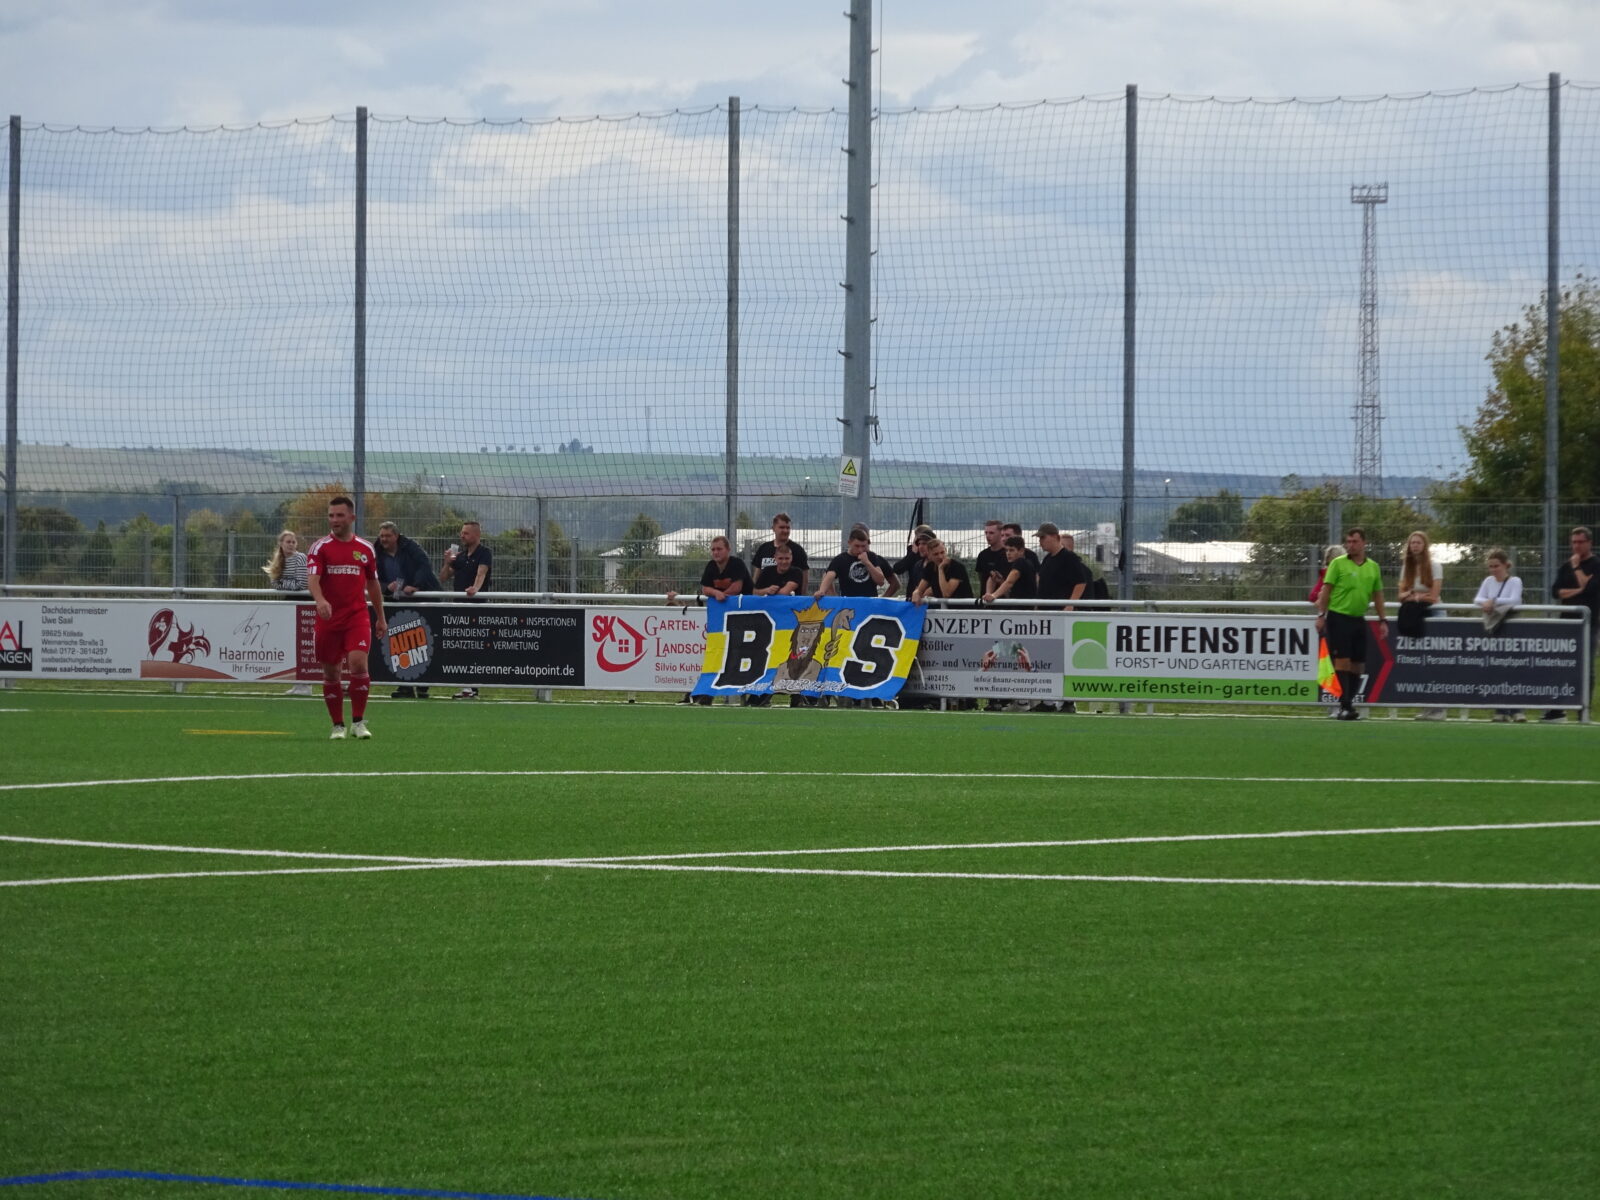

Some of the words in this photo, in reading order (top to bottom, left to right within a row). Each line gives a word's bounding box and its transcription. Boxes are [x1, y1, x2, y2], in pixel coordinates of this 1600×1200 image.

[42, 606, 108, 614] Dachdeckermeister
[58, 616, 73, 624] Saal
[443, 614, 470, 625] TÜV/AU
[478, 616, 518, 626] REPARATUR
[526, 617, 576, 626] INSPEKTIONEN
[922, 618, 992, 634] ONZEPT
[1000, 618, 1052, 636] GmbH
[443, 628, 490, 637] REIFENDIENST
[498, 629, 542, 638] NEUAUFBAU
[592, 615, 616, 642] SK
[389, 626, 427, 655] AUTO
[443, 640, 484, 650] ERSATZTEILE
[493, 641, 540, 650] VERMIETUNG
[1116, 625, 1310, 655] REIFENSTEIN
[1396, 636, 1462, 650] ZIERENNER
[1466, 636, 1576, 652] SPORTBETREUUNG
[219, 647, 284, 661] Haarmonie
[656, 638, 706, 658] LANDSCH
[712, 610, 776, 688] B
[840, 615, 906, 690] S
[656, 662, 677, 672] Silvio
[942, 658, 958, 668] und
[962, 658, 1052, 670] Versicherungsmakler
[1168, 658, 1198, 670] UND
[1201, 658, 1310, 672] GARTENGERÄTE
[1397, 654, 1422, 664] Fitness
[1427, 656, 1456, 665] Personal
[1458, 656, 1484, 666] Training
[1535, 657, 1576, 667] Kinderkurse
[232, 664, 242, 672] Ihr
[245, 664, 271, 674] Friseur
[443, 663, 574, 678] www.zierenner-autopoint.de
[654, 676, 686, 686] Distelweg
[1072, 680, 1310, 698] www.reifenstein-garten.de
[1396, 681, 1576, 699] www.zierenner-sportbetreuung.de
